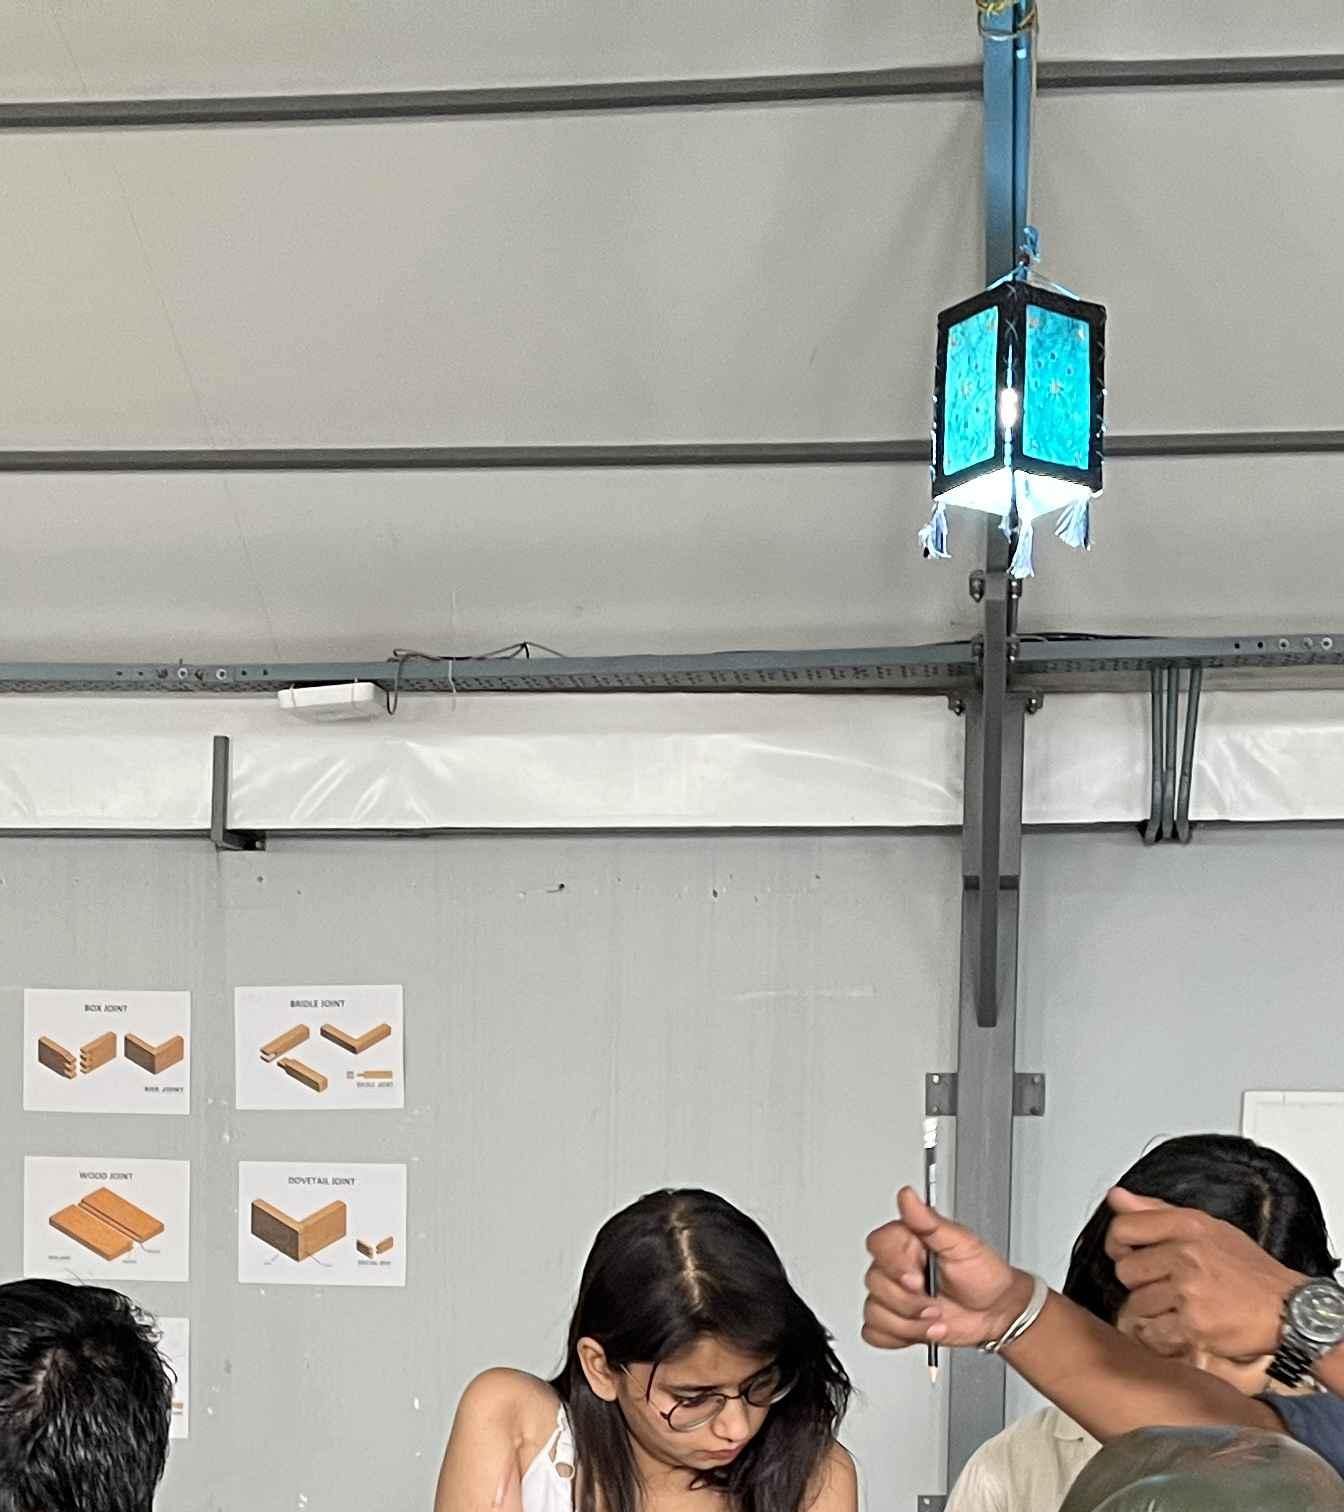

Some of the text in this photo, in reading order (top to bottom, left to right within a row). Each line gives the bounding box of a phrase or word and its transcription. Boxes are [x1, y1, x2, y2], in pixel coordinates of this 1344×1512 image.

[290, 999, 345, 1008] BRIDLE JOINT
[84, 1004, 128, 1013] BOX JOINT
[79, 1171, 133, 1180] WOOD JOINT
[288, 1176, 355, 1185] DOVETAIL JOINT
